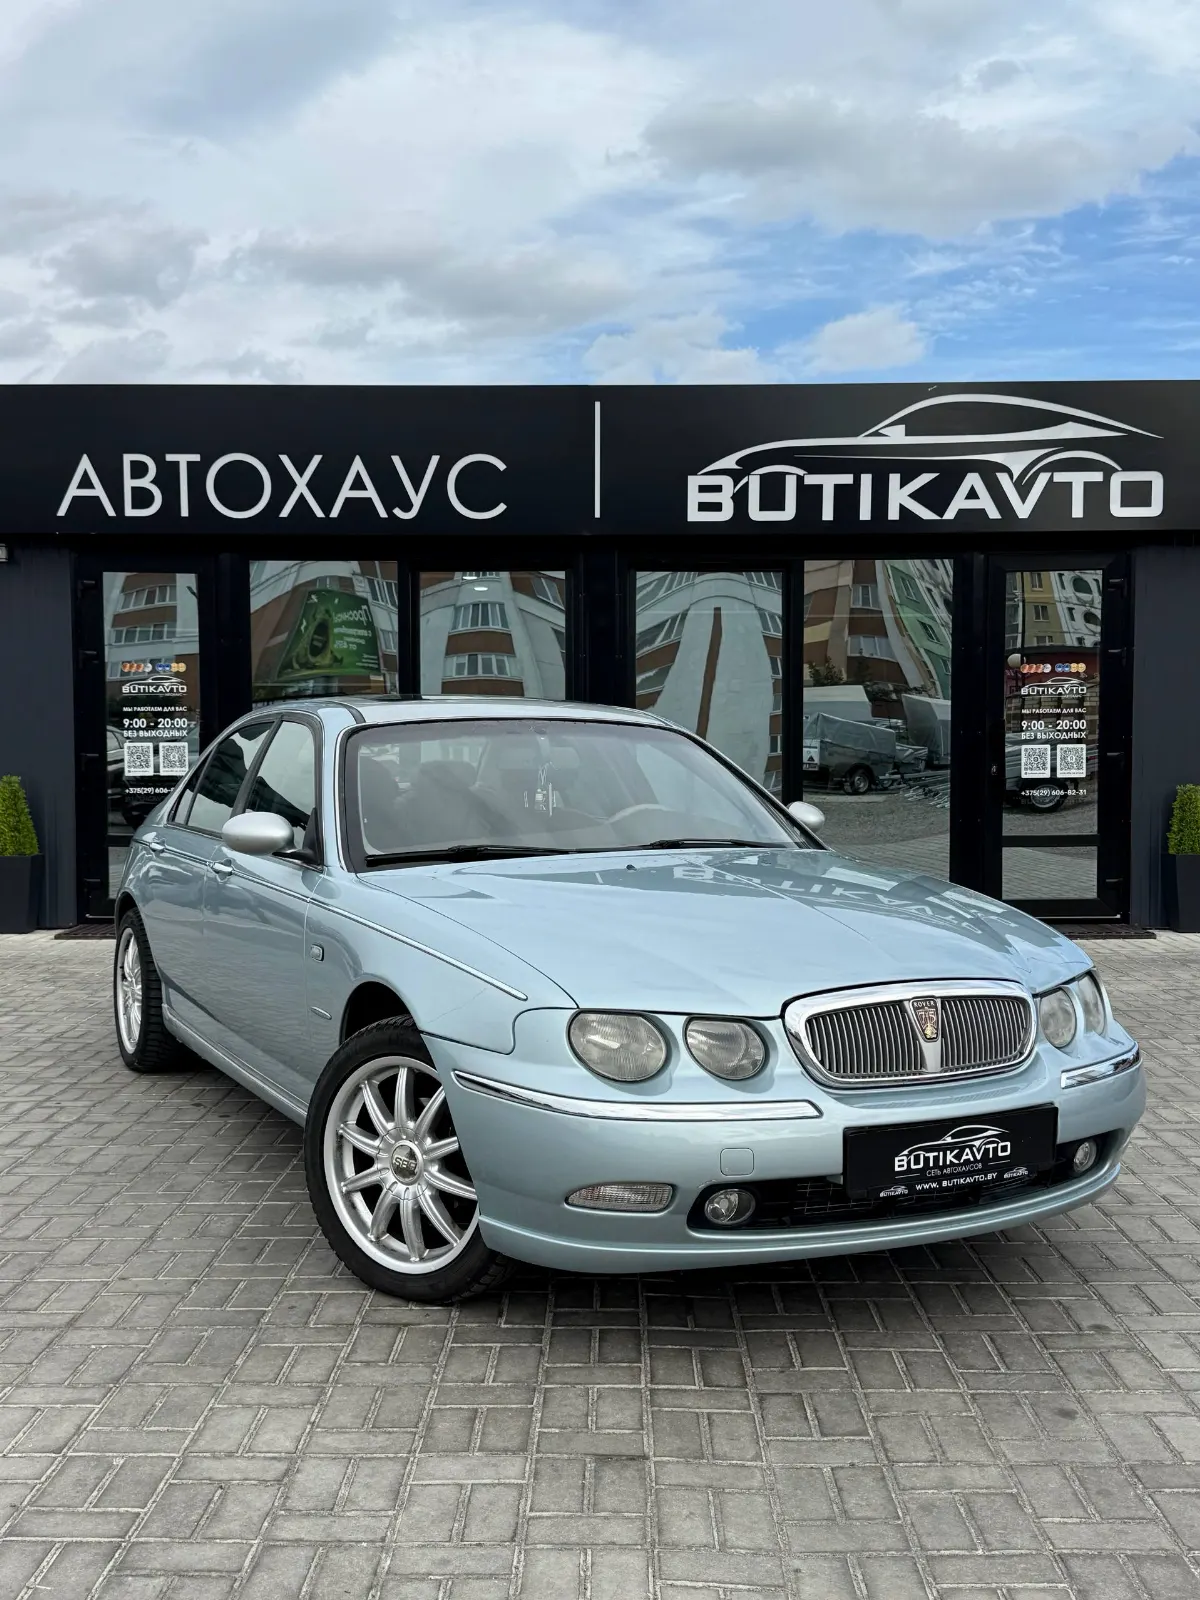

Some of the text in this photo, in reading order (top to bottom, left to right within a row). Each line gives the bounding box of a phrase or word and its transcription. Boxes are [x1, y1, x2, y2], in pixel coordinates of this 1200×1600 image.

[56, 452, 508, 521] АВТОХАУС
[687, 470, 1164, 522] BUTIKAVTO
[121, 685, 187, 693] BUTIKAVTO
[1021, 686, 1087, 695] BUTIKAVTO
[123, 718, 147, 728] 9:00
[157, 718, 188, 728] 20:00
[1021, 720, 1045, 730] 9:00
[1055, 719, 1087, 730] 20:00
[123, 730, 188, 738] БЕЗ ВЫХОДНЫХ
[1021, 731, 1087, 740] БЕЗ ВЫХОДНЫХ
[913, 1000, 935, 1008] ROVER
[894, 1141, 1011, 1172] BUTIKAVTO
[926, 1162, 983, 1178] СЕТЬ АВТОХАУСОВ
[915, 1172, 998, 1191] WWW. BUTIKAVTO.BY
